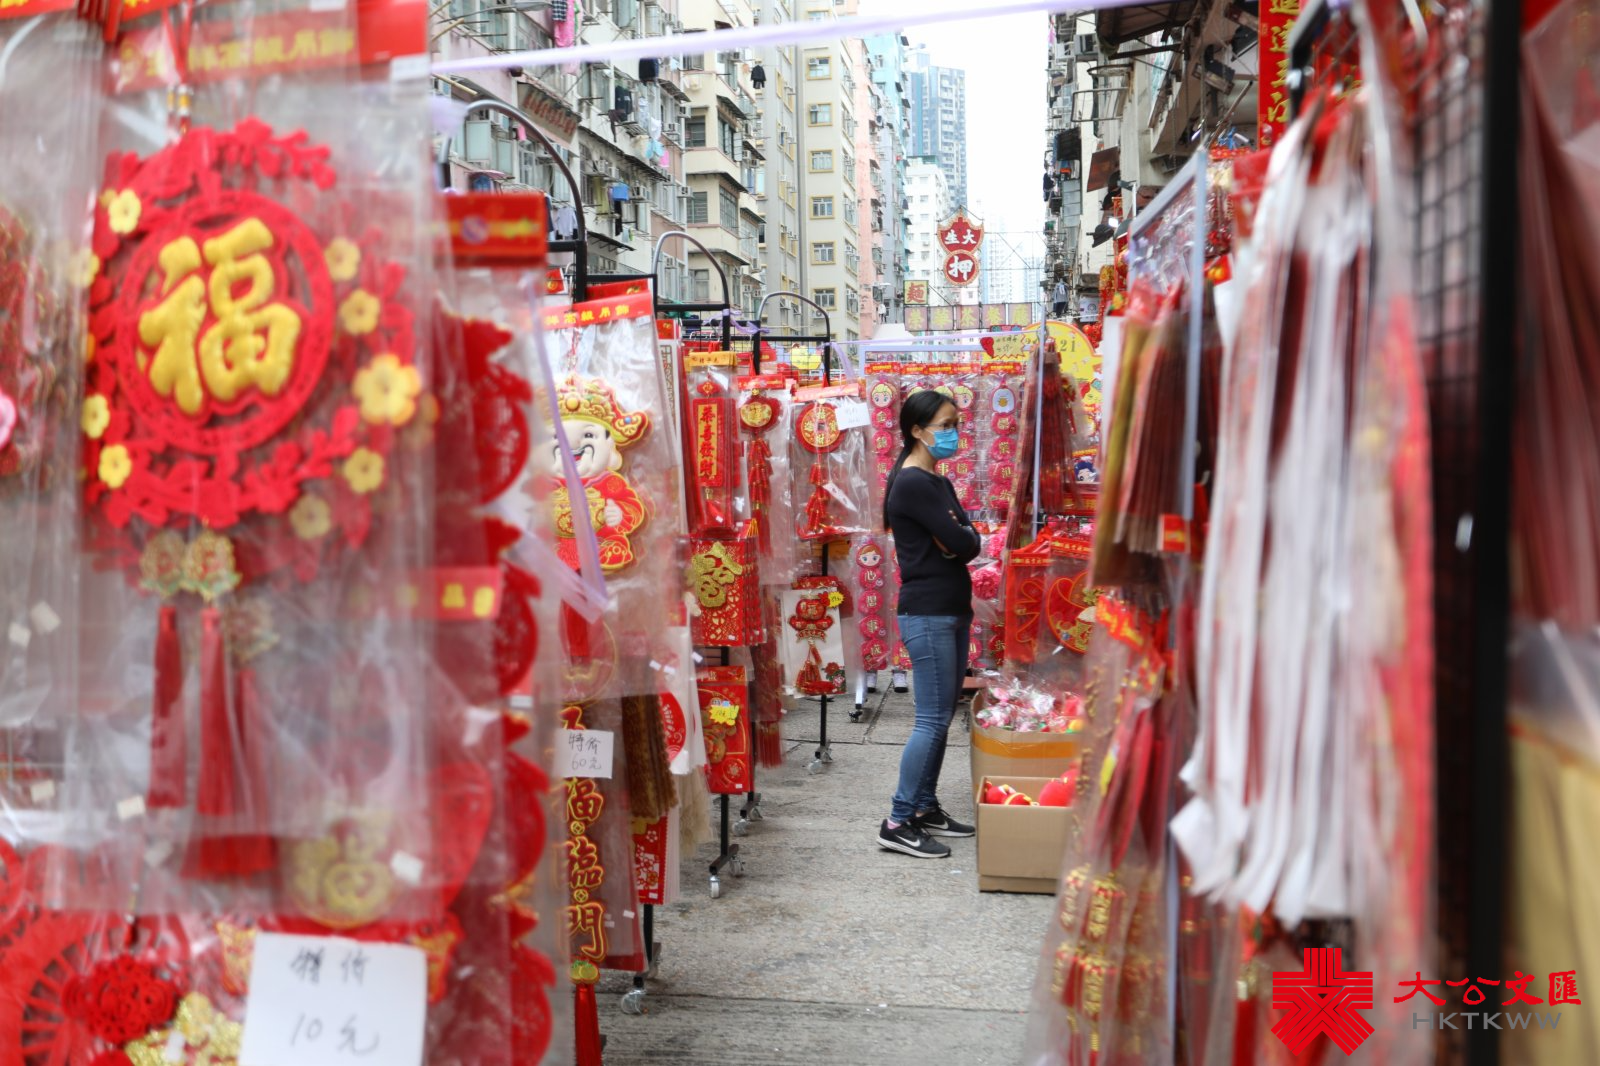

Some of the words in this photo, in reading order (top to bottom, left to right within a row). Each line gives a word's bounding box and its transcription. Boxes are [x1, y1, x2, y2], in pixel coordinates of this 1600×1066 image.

[948, 256, 973, 281] 押
[140, 218, 301, 415] 福
[699, 405, 715, 477] 恭喜發財
[864, 571, 881, 655] 心想事成
